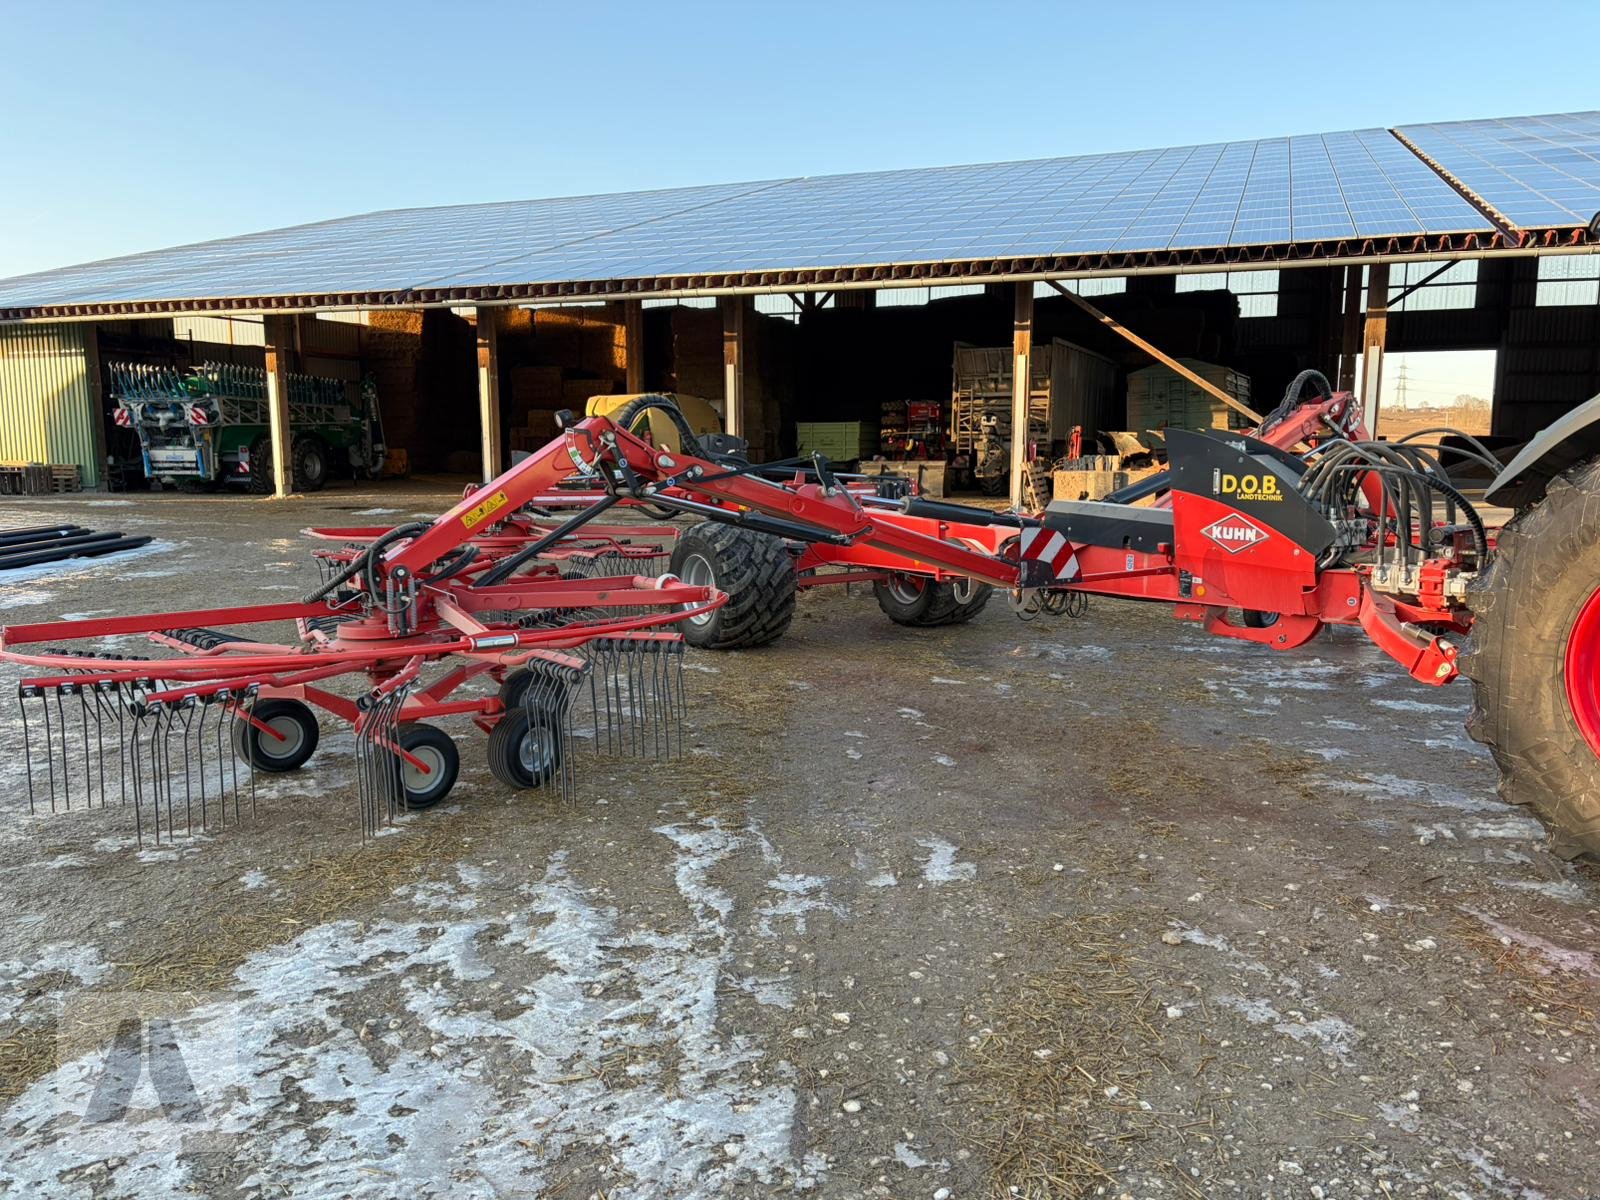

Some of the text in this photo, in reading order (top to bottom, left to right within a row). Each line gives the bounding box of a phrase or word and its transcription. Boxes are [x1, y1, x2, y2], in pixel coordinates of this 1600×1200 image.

[1222, 474, 1281, 494] D.O.B.
[1236, 493, 1283, 502] LANDTECHNIK
[1211, 525, 1257, 542] KUHN
